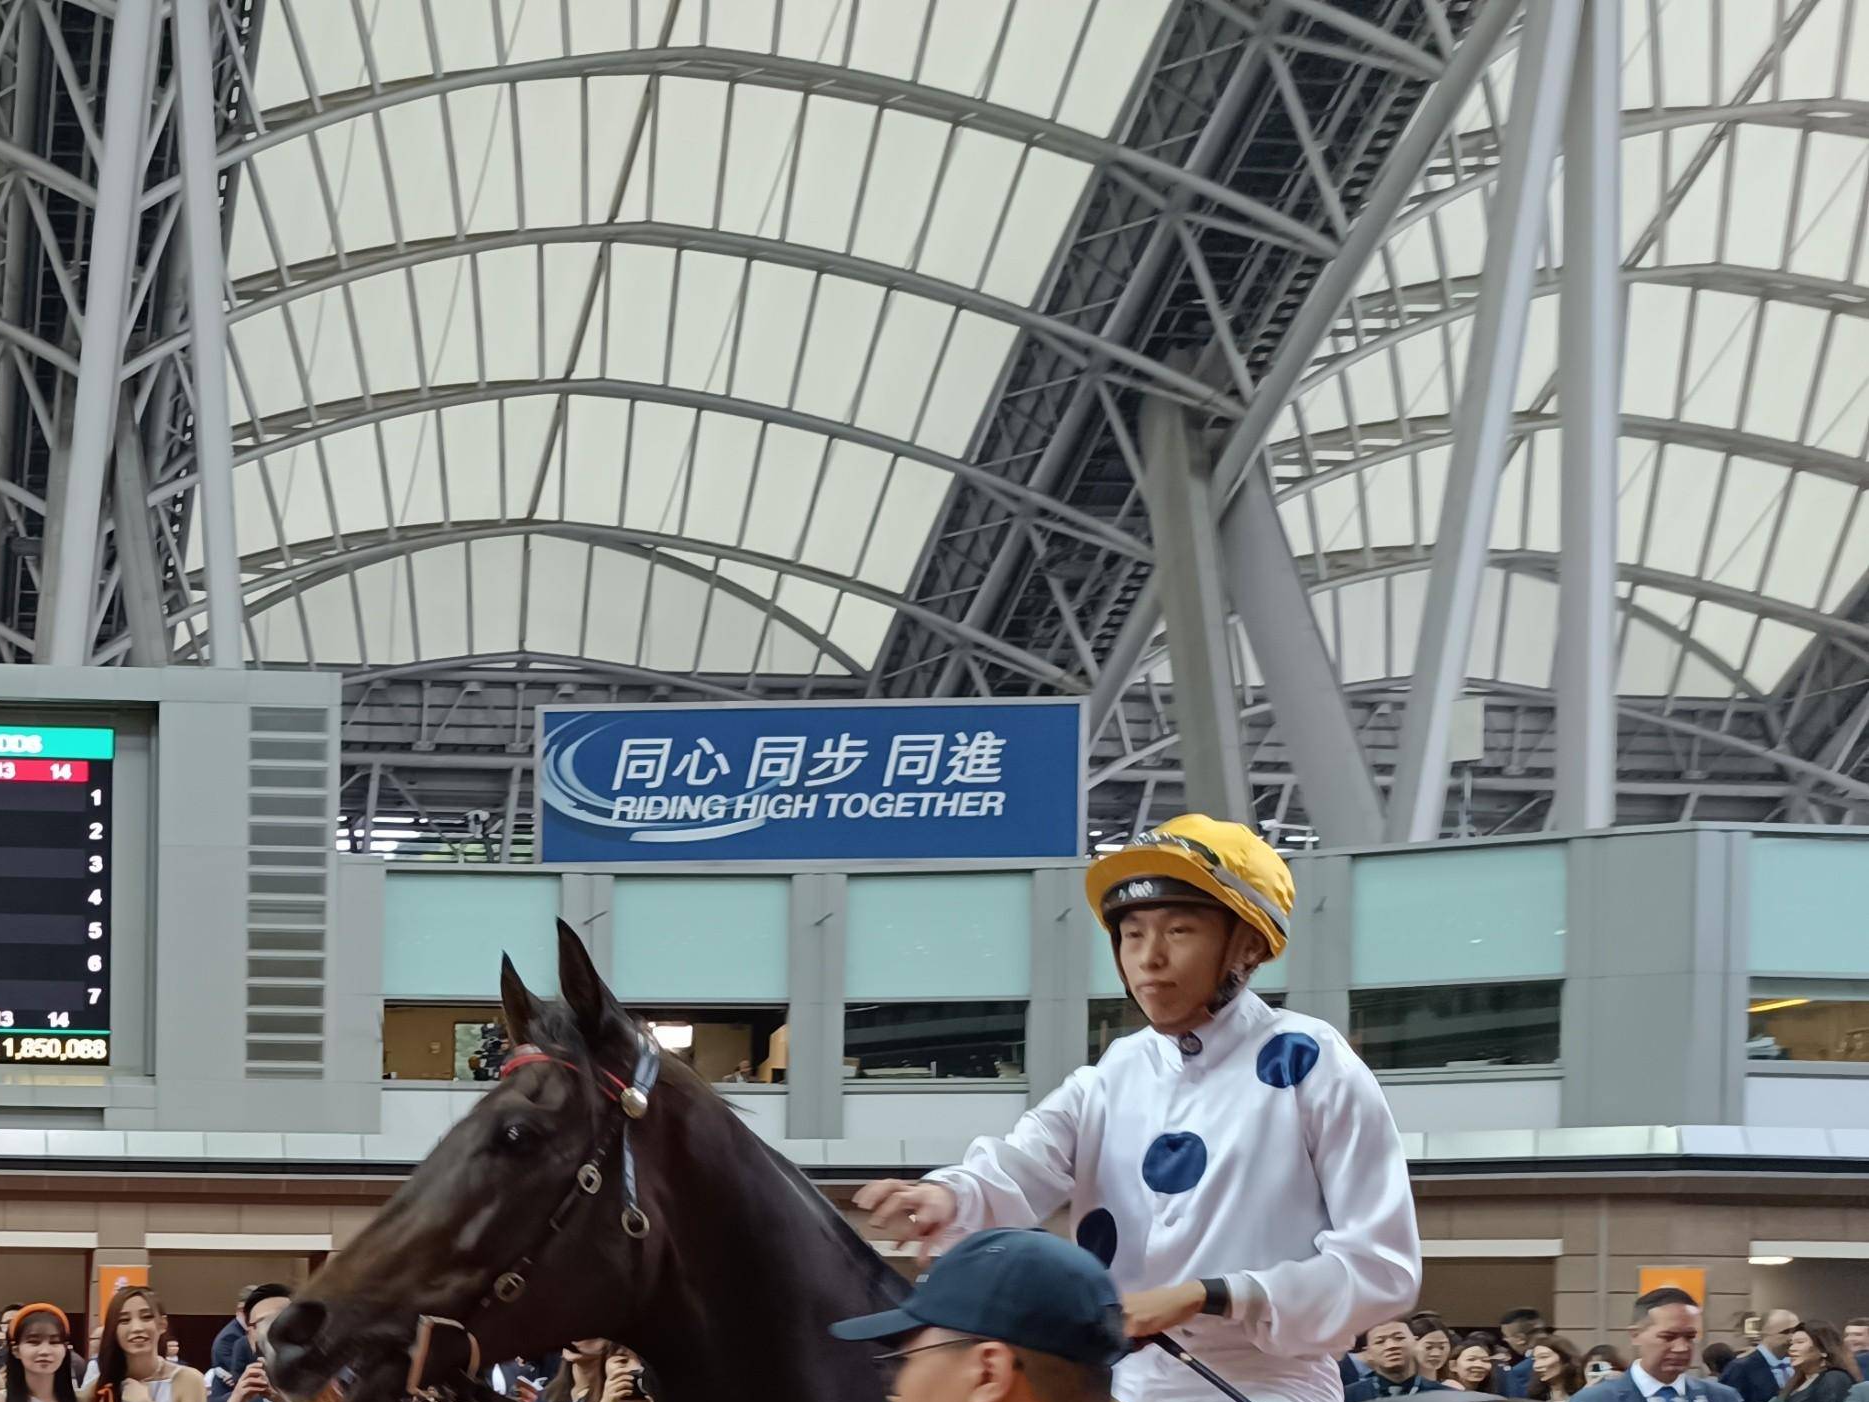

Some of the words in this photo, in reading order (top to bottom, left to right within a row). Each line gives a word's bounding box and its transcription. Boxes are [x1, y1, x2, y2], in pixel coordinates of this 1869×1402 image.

[611, 736, 731, 790] 同心
[745, 734, 869, 789] 同步
[882, 731, 1007, 787] 同進
[51, 764, 71, 779] 14
[91, 789, 101, 805] 1
[611, 797, 728, 821] RIDING
[732, 795, 816, 819] HIGH
[827, 791, 1005, 818] TOGETHER
[89, 823, 103, 839] 2
[89, 856, 103, 872] 3
[88, 889, 102, 905] 4
[89, 922, 102, 939] 5
[88, 955, 101, 971] 6
[88, 988, 101, 1004] 7
[48, 1012, 69, 1027] 14
